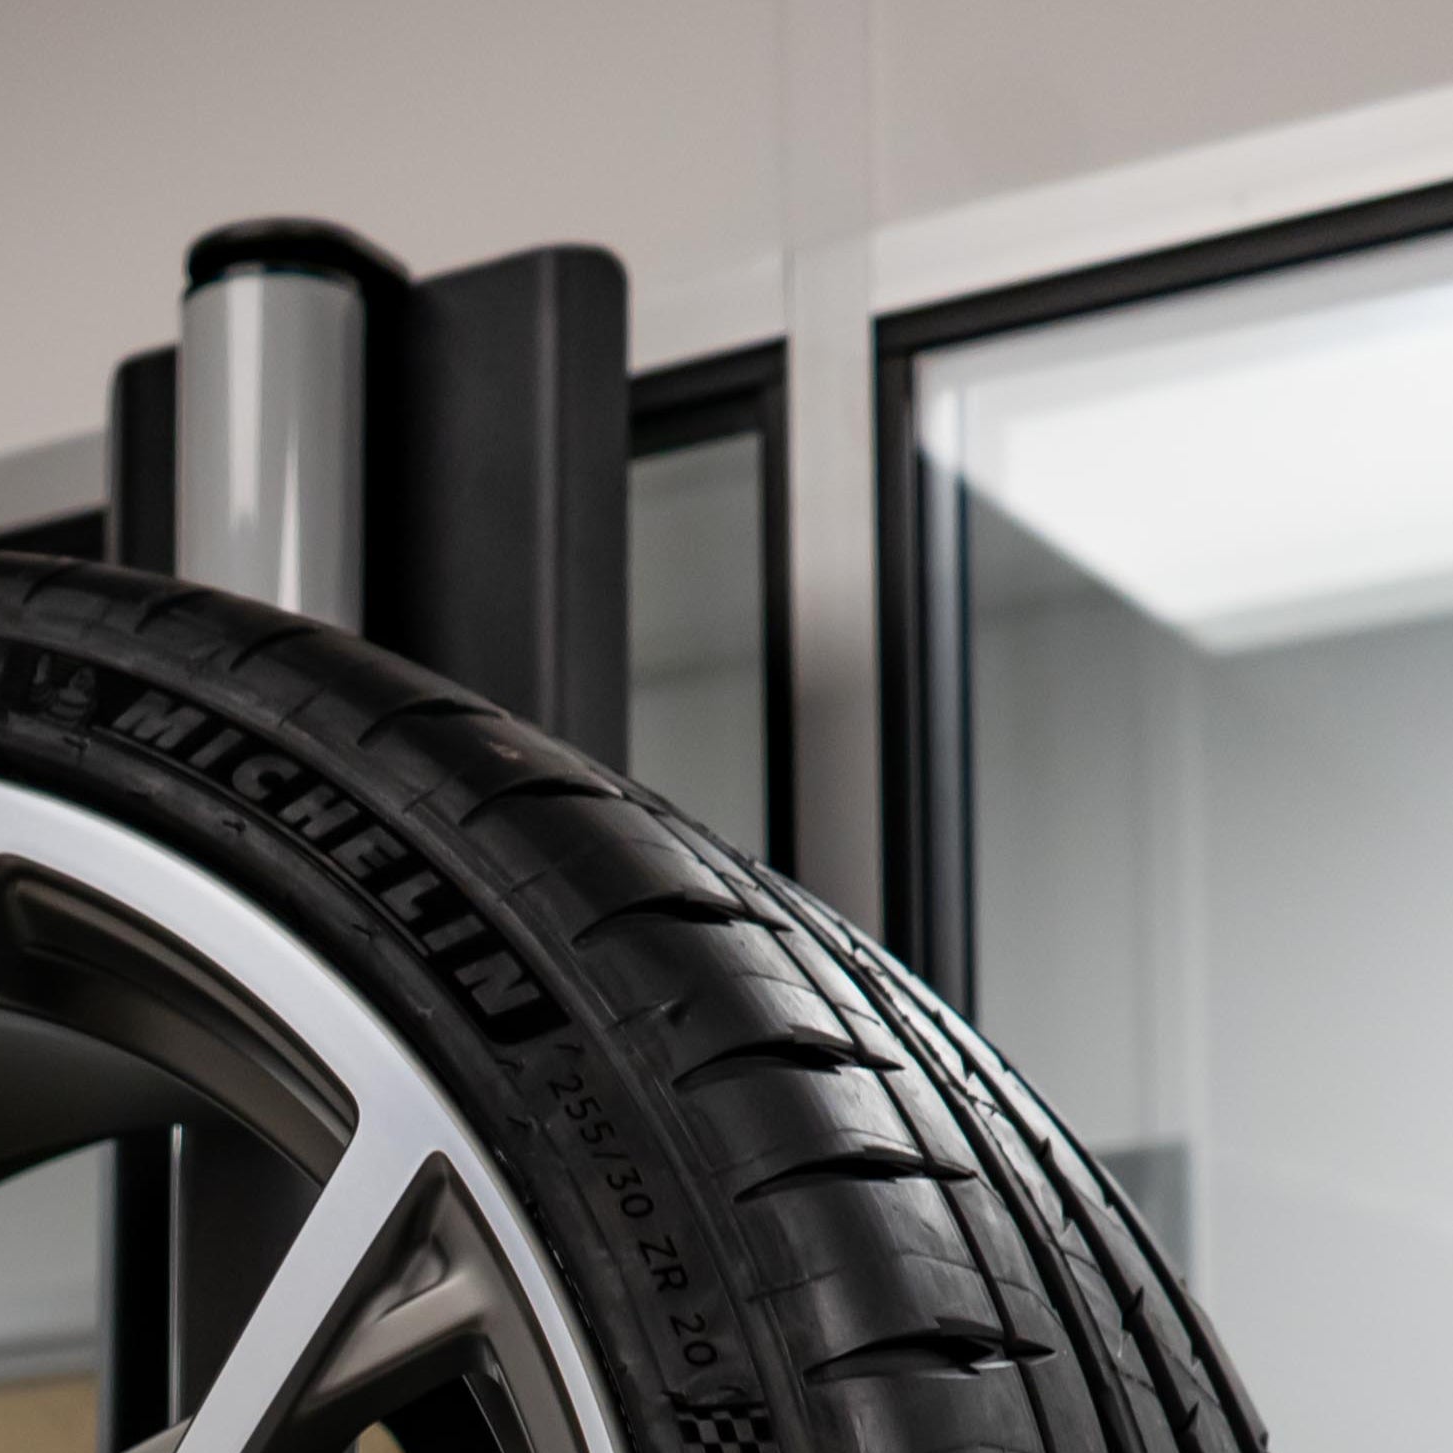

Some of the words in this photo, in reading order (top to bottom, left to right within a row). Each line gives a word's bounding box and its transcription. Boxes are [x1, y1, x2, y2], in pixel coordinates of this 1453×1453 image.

[111, 692, 541, 1016] MICHELIN
[548, 1072, 654, 1219] 255/30
[639, 1235, 689, 1297] ZR
[670, 1312, 718, 1369] 20
